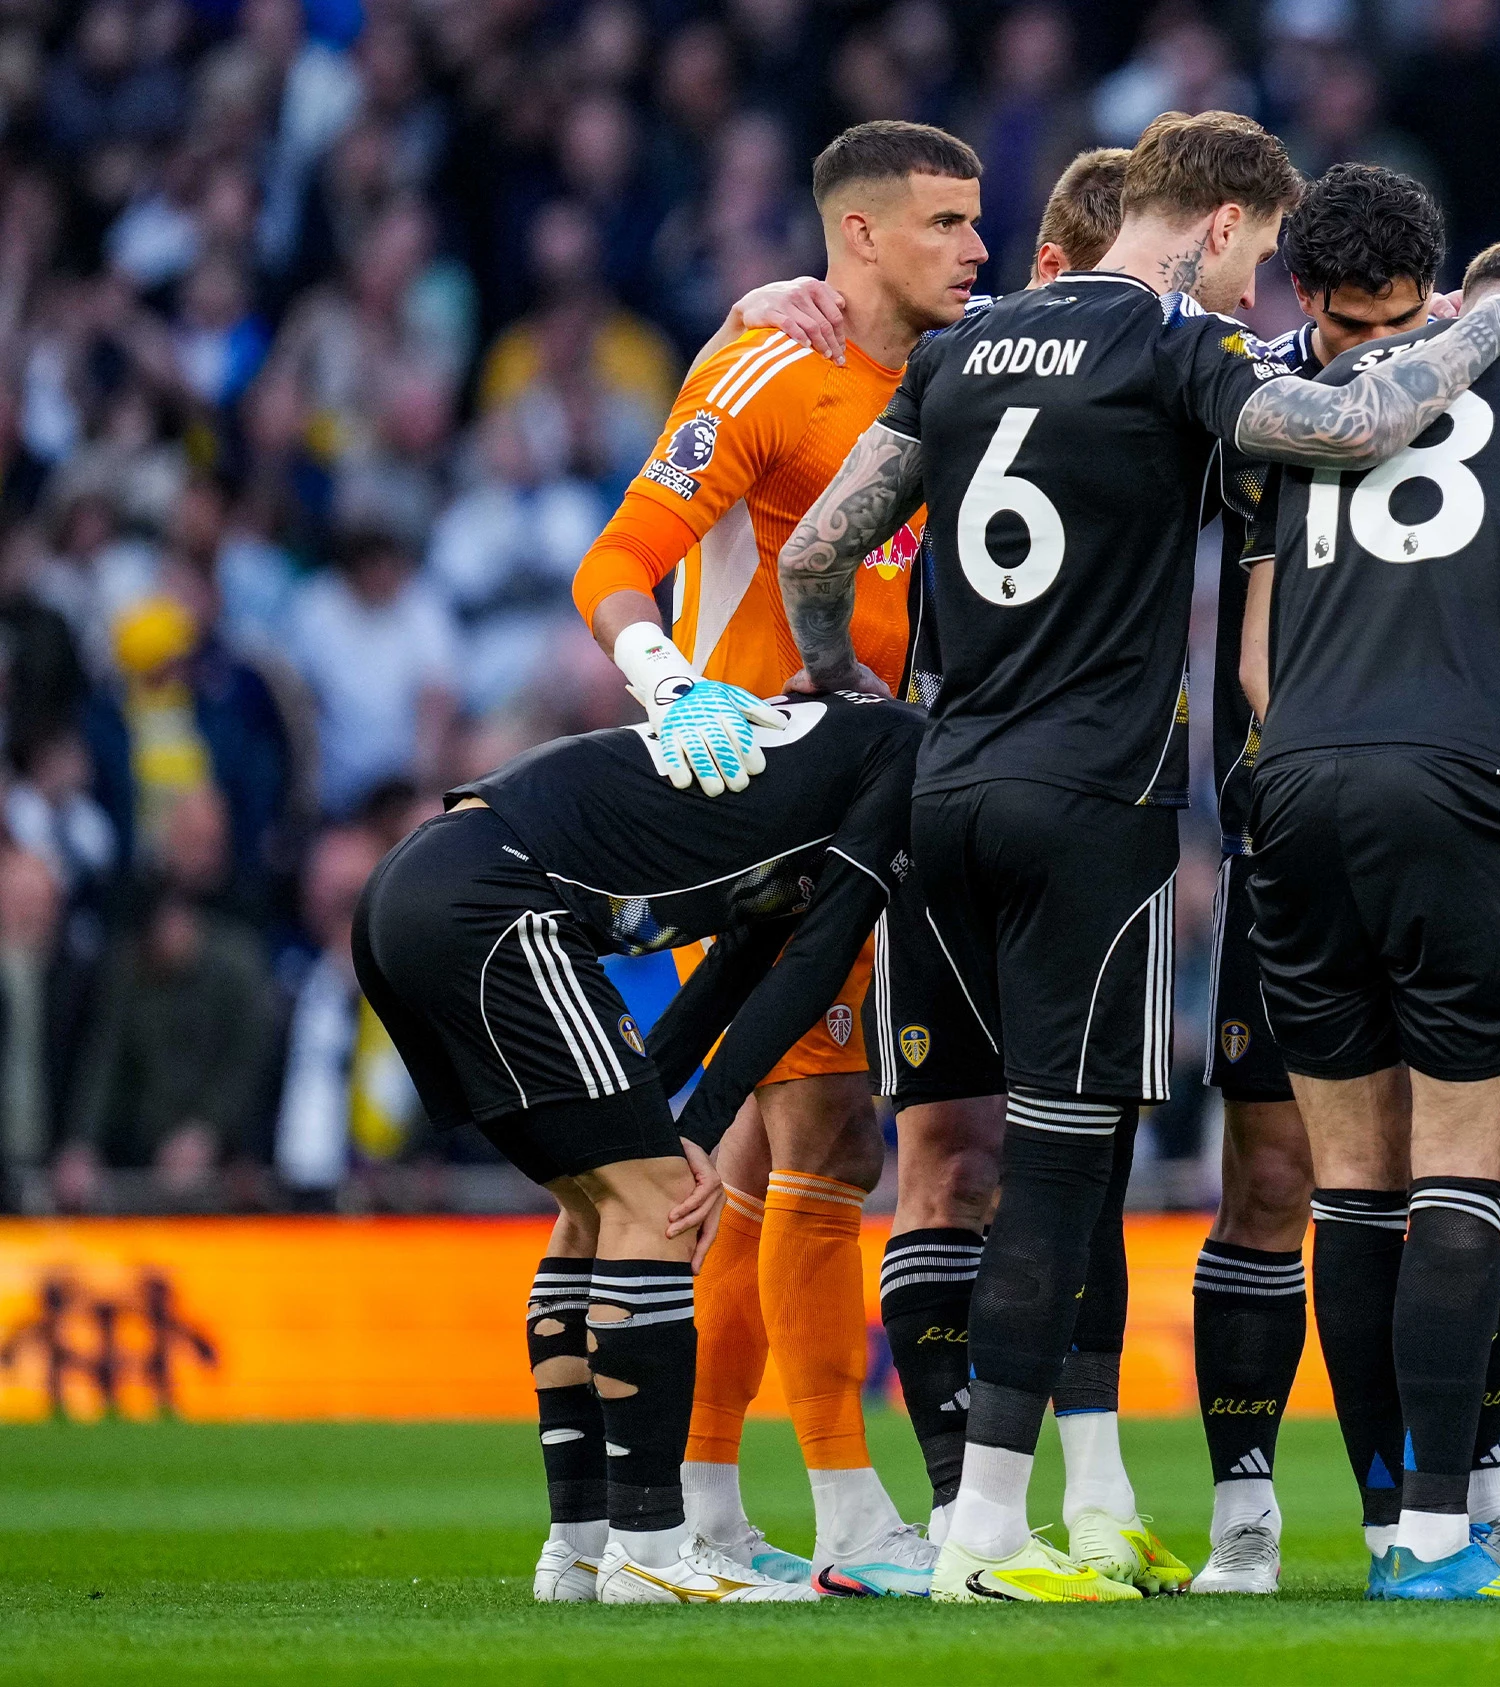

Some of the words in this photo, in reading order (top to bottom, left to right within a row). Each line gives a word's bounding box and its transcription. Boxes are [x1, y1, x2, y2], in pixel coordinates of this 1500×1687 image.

[961, 337, 1088, 377] RODON
[650, 458, 665, 473] No
[662, 465, 695, 490] room
[656, 473, 693, 501] racism
[1306, 388, 1495, 569] 18
[957, 406, 1066, 607] 6
[1208, 1397, 1278, 1416] LUFC
